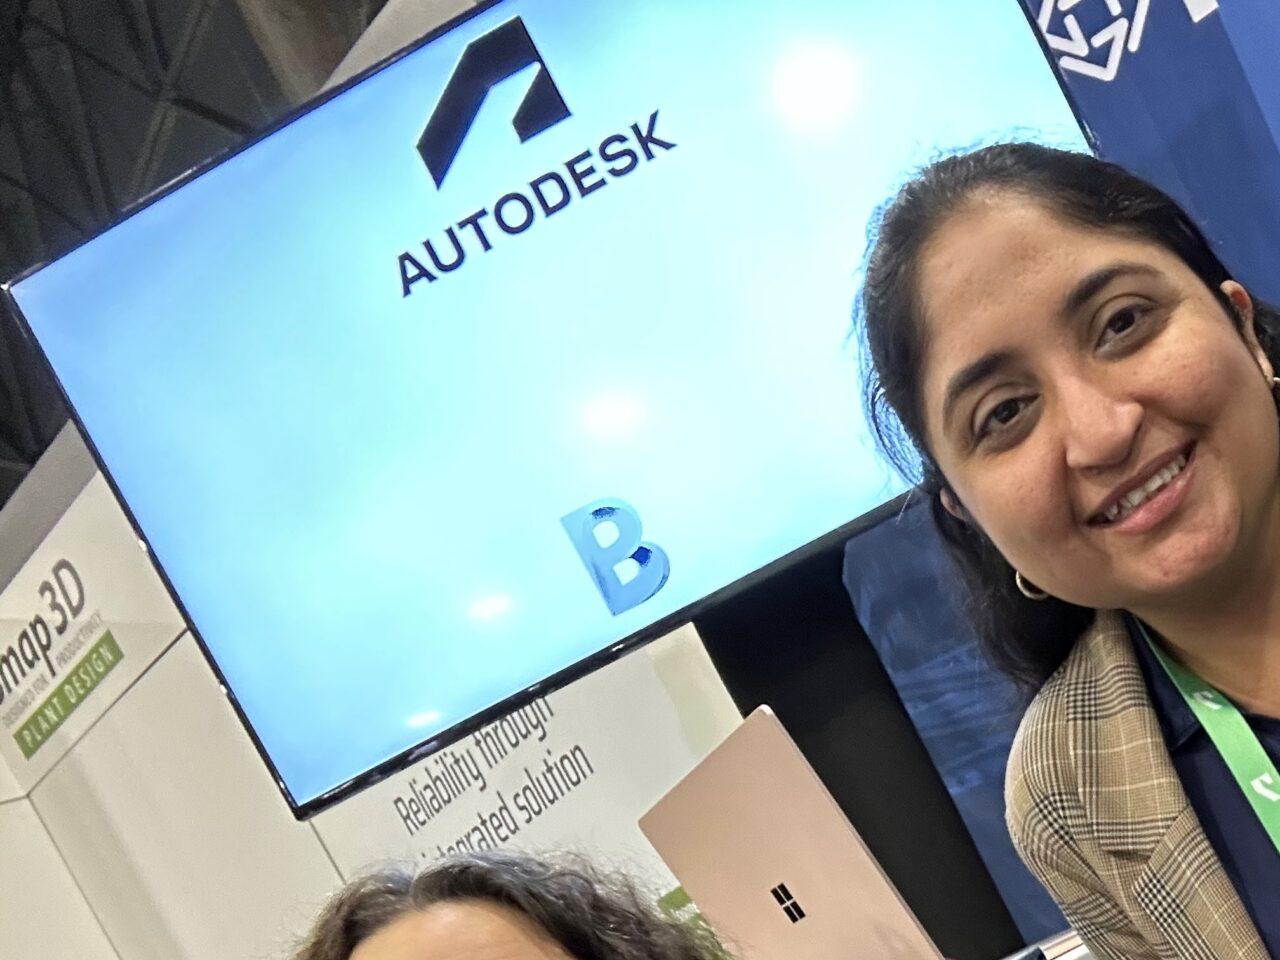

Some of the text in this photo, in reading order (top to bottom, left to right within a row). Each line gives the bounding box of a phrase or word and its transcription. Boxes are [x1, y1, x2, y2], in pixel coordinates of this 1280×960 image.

[398, 109, 678, 298] AUTODESK
[560, 497, 671, 617] B
[0, 558, 85, 705] map 3D
[22, 643, 115, 748] PLANT DESIGN
[393, 747, 488, 837] Reliability
[513, 744, 594, 824] solution
